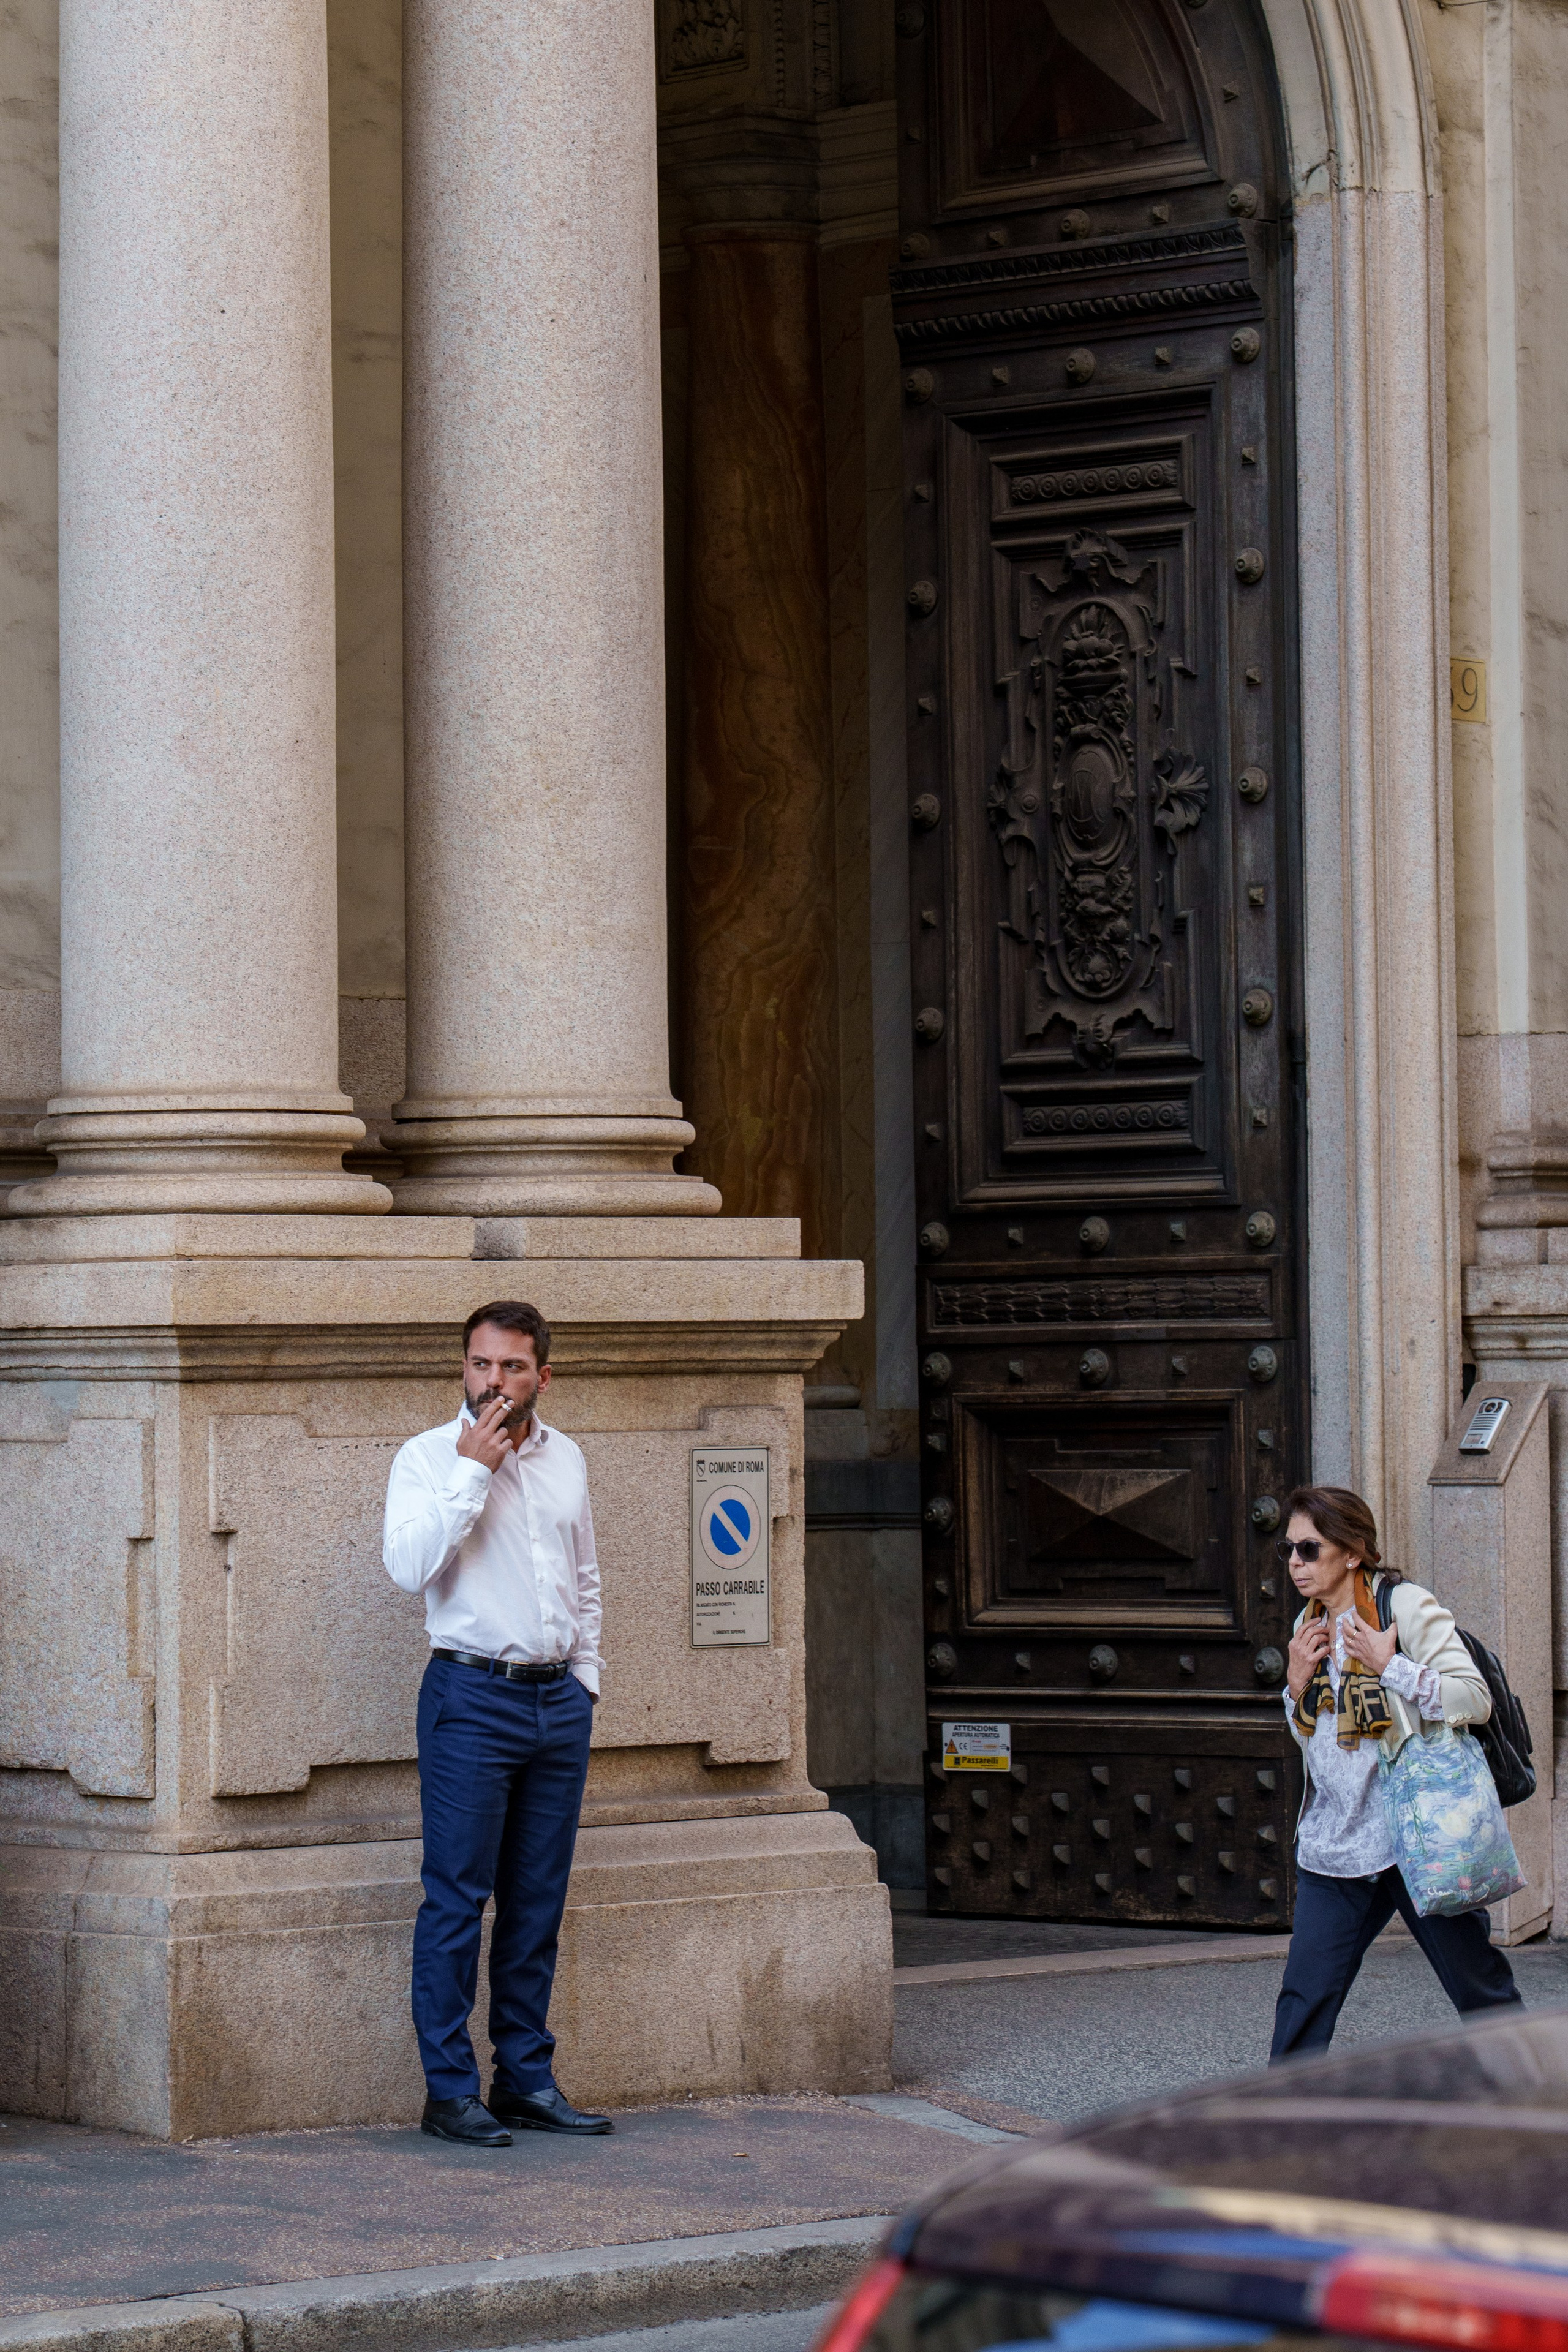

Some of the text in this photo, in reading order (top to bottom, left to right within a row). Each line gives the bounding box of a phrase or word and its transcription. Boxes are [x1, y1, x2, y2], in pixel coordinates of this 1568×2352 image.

[1450, 667, 1479, 712] 9
[709, 1461, 764, 1474] COMUNE DI ROMA
[696, 1580, 764, 1596] PASSO CARRABILE
